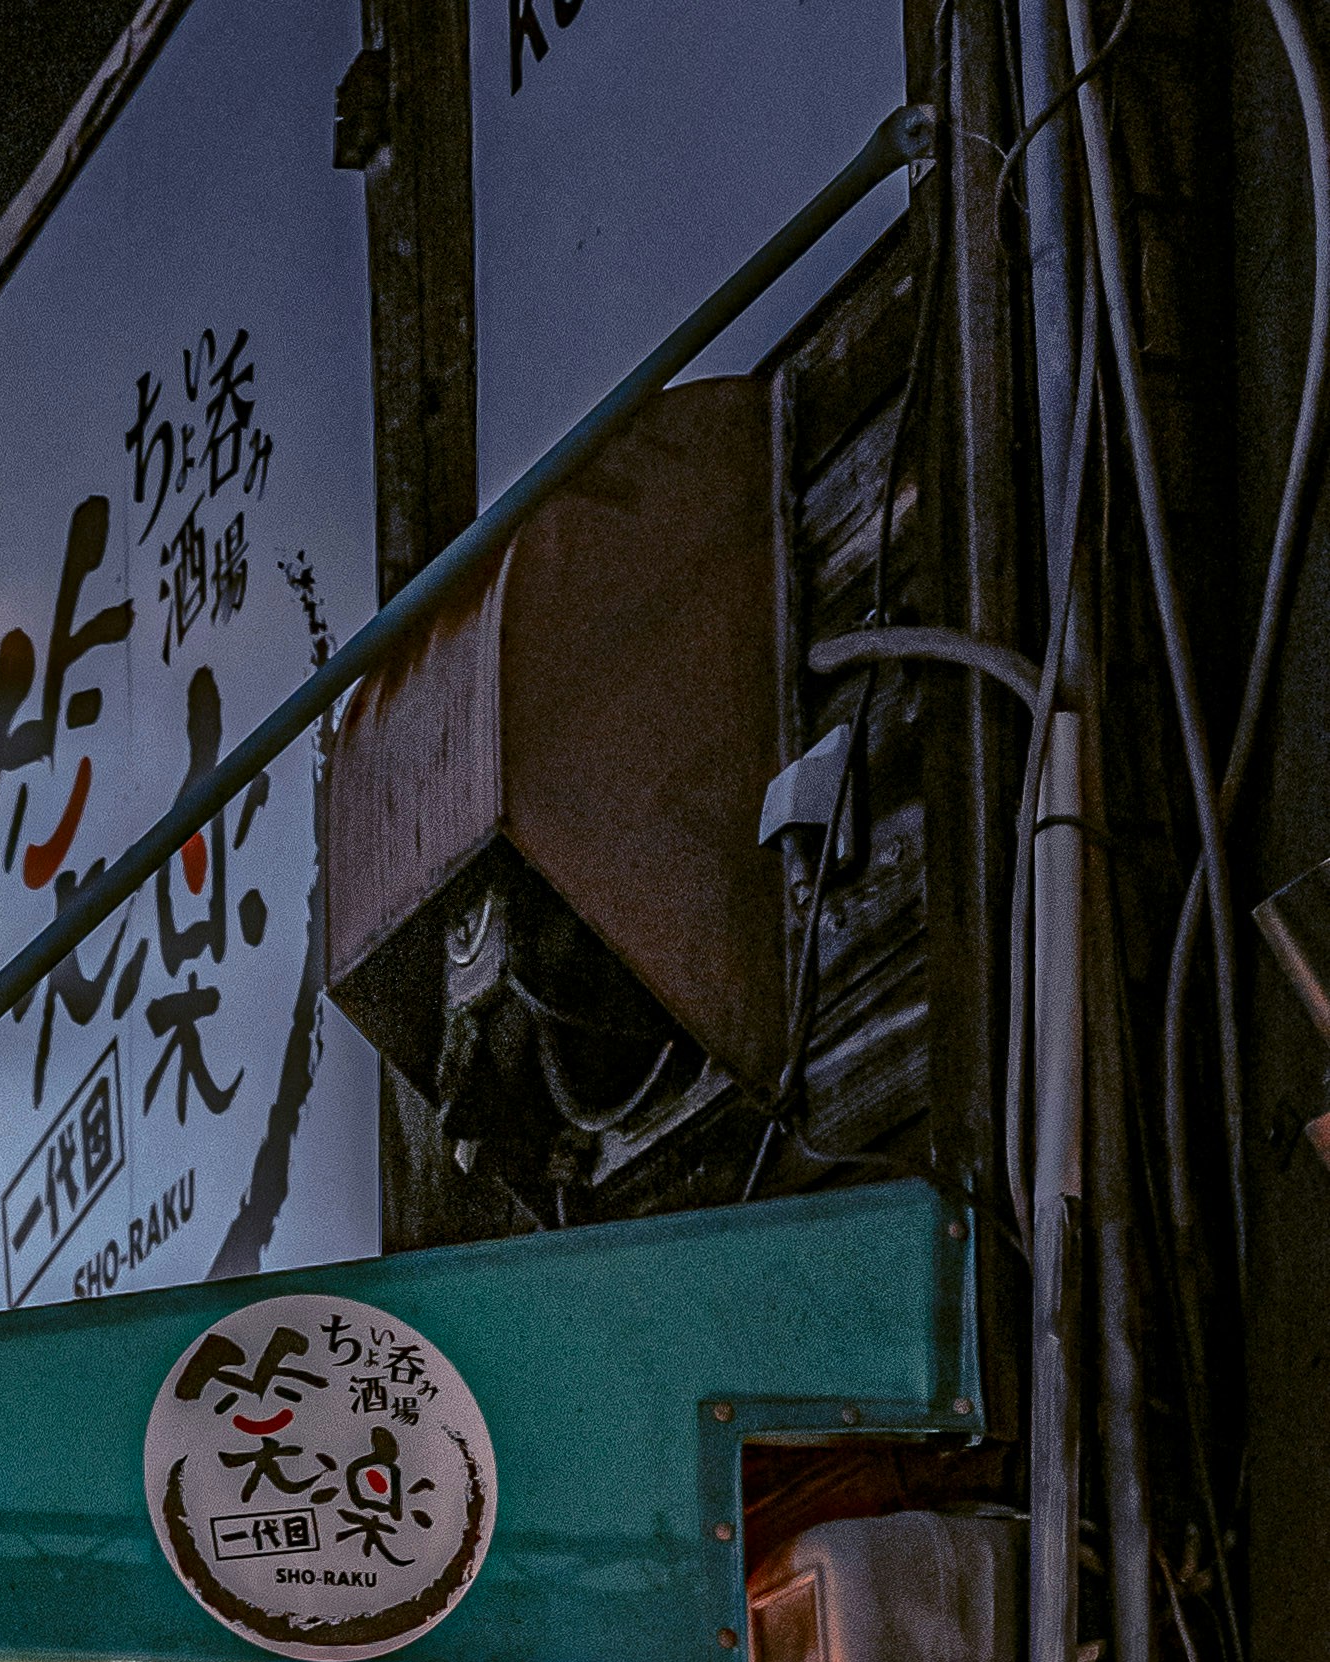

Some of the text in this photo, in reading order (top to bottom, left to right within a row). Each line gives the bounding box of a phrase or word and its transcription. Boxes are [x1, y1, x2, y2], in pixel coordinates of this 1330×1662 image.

[159, 490, 249, 666] 酒場
[73, 1168, 195, 1298] SHO-RAKU
[348, 1374, 421, 1426] 酒場
[275, 1567, 377, 1588] SHO-RAKU
